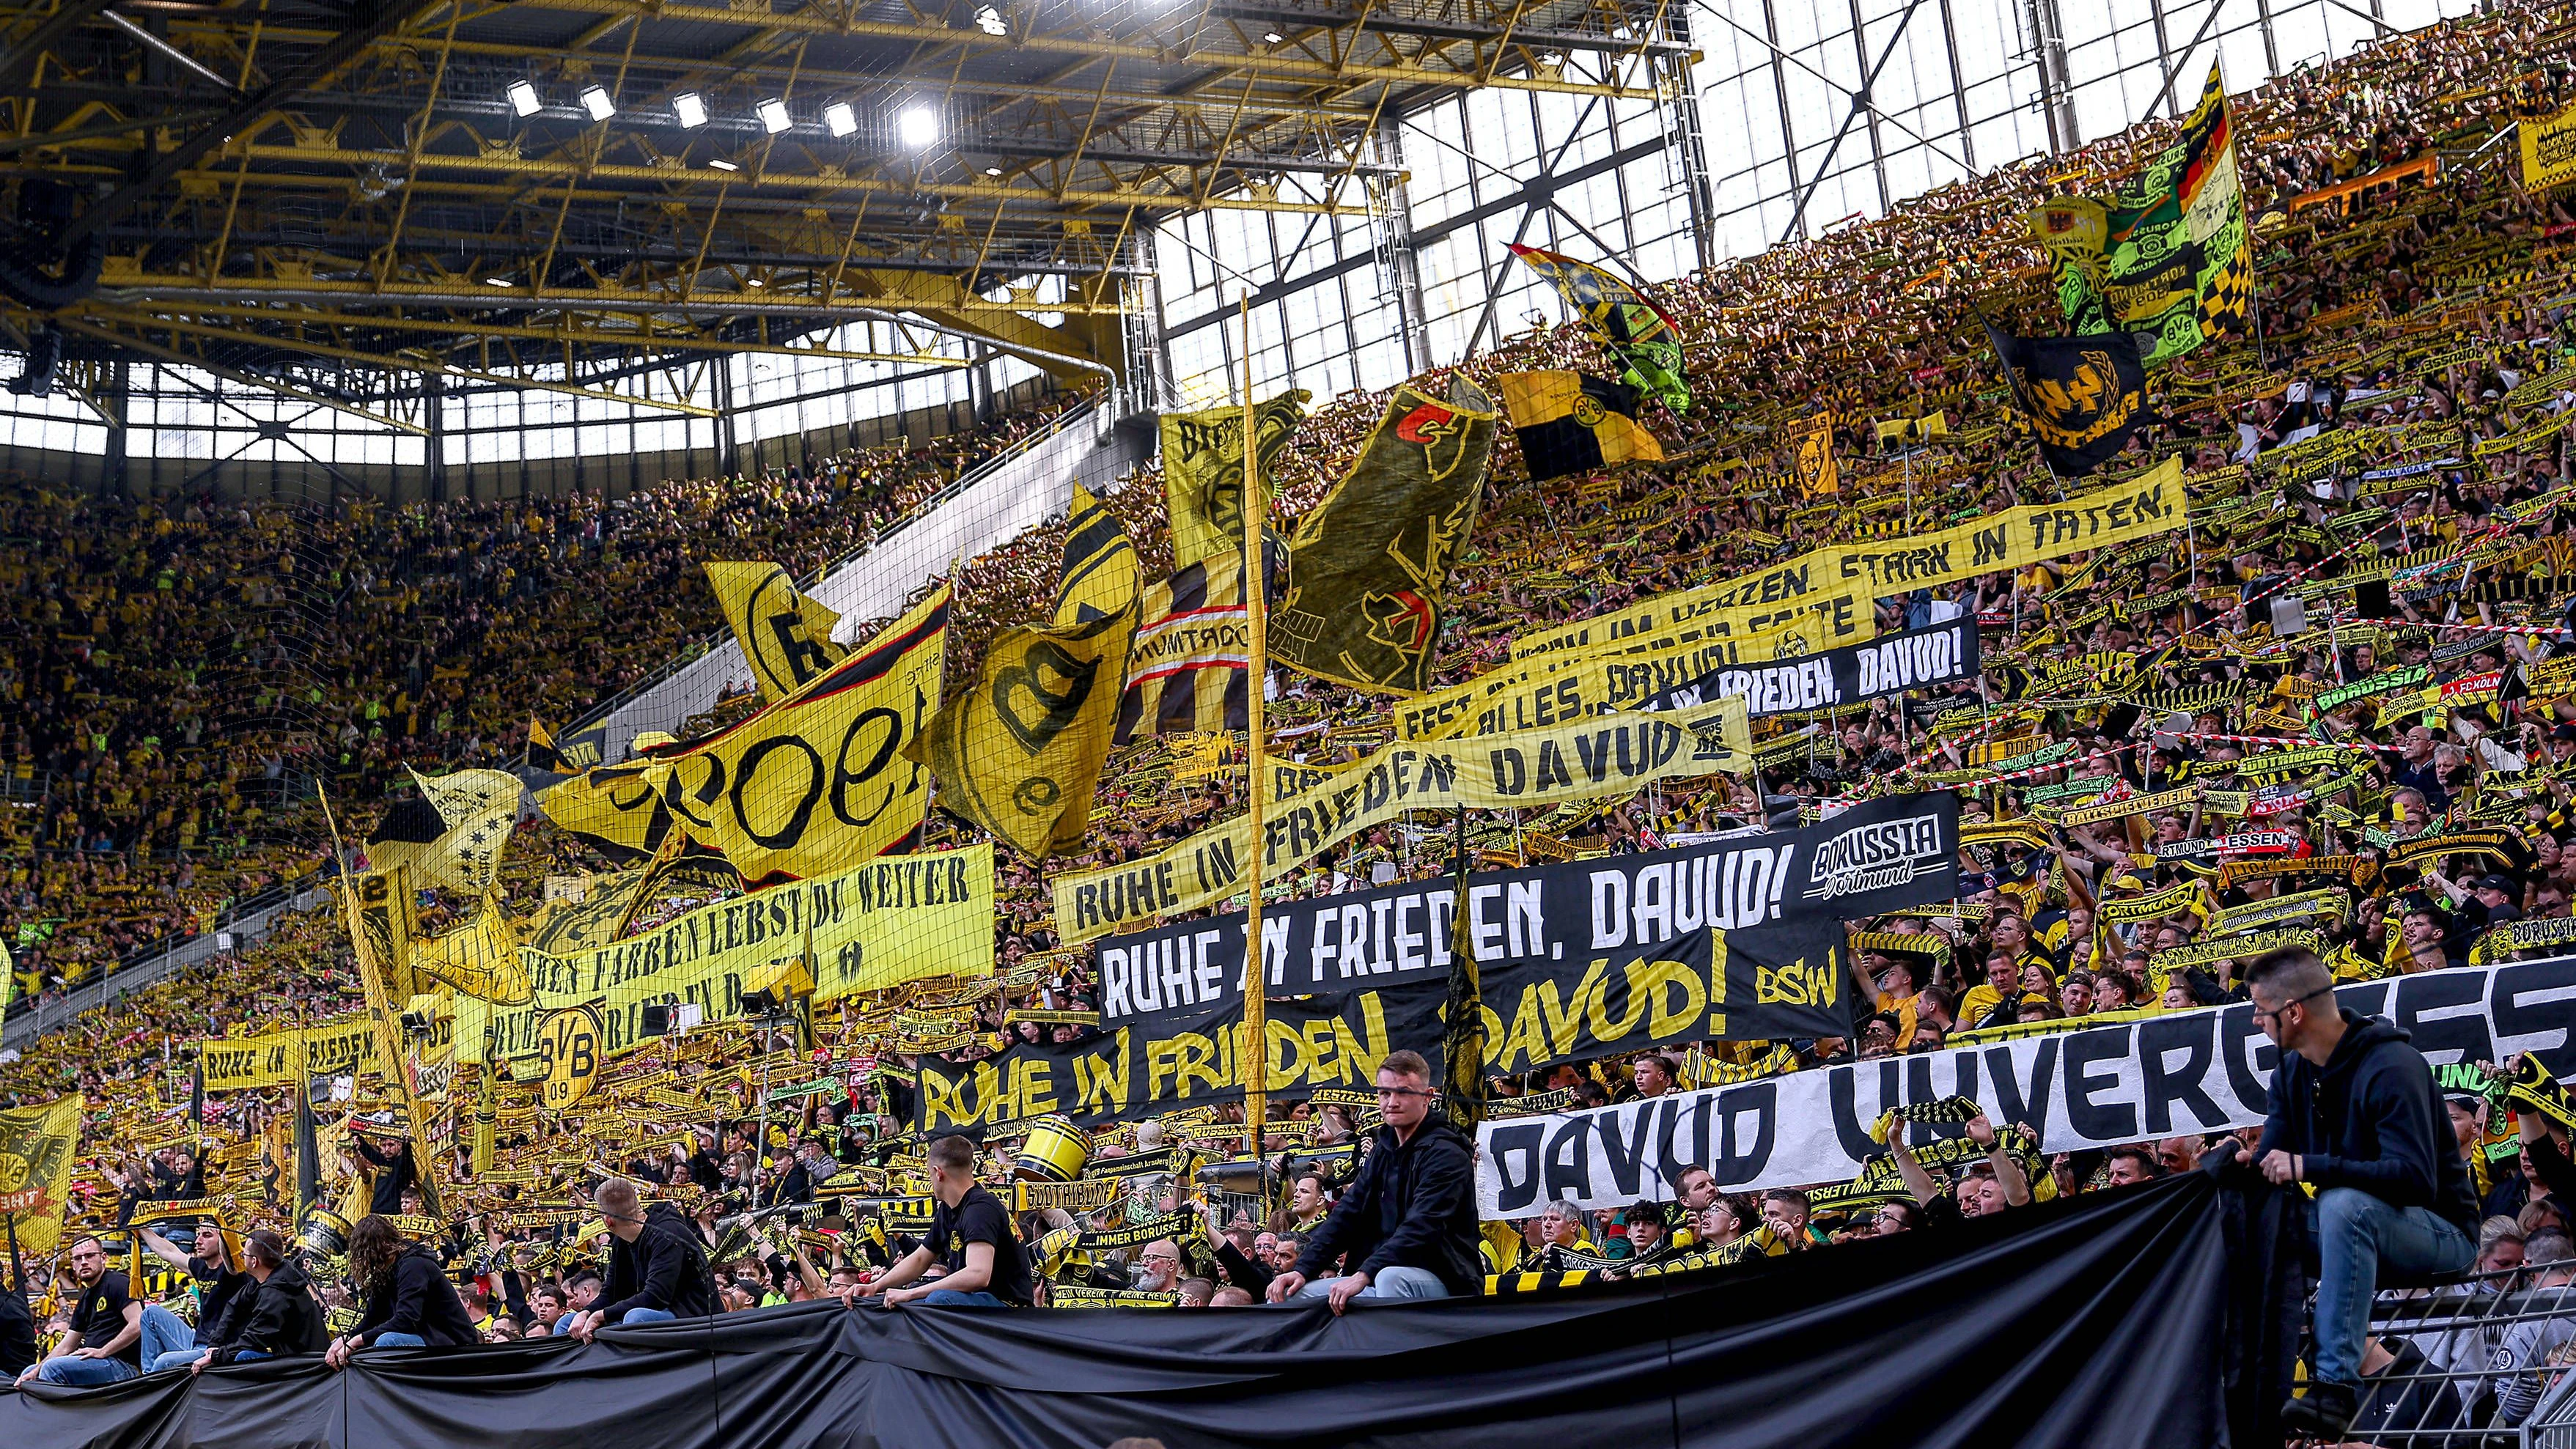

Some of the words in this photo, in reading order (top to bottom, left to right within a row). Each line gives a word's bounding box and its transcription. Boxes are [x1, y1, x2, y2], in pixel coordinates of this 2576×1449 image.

[1578, 397, 1603, 416] BVB
[2484, 432, 2528, 451] BORUSSIA
[1840, 540, 1953, 585] STARK
[1972, 522, 2007, 567] IN
[2028, 483, 2173, 550] TATEN,
[2432, 642, 2469, 659] BORUSSIA
[1718, 656, 1841, 714] FRIEDEN,
[1855, 626, 1962, 696] DAVUD!
[2086, 651, 2136, 682] BVB
[2316, 668, 2428, 710] BORUSSIA
[2473, 676, 2501, 691] KÖLN
[2384, 699, 2426, 721] DORTMUND
[2385, 692, 2423, 712] BORUSSIA
[1404, 693, 1471, 740] FEST
[1075, 860, 1179, 930] RUHE
[1195, 837, 1237, 893] IN
[1265, 750, 1458, 866] FRIEDEN
[1490, 721, 1682, 795] DAVUD
[1812, 814, 1943, 883] BORUSSIA
[2228, 832, 2284, 849] ESSEN
[2400, 835, 2441, 855] Borussia
[2441, 832, 2498, 846] Dortmund
[1824, 859, 1914, 902] Dortmund
[592, 918, 699, 992] FARBEN
[708, 888, 802, 956] LEBST
[812, 877, 846, 930] DU
[857, 855, 969, 908] WEITER
[1104, 929, 1223, 1020] RUHE
[1589, 844, 1795, 951] DAVUD!
[540, 1017, 595, 1082] BVB
[921, 1047, 1059, 1132] RUHE
[1071, 1026, 1131, 1117] IN
[1755, 945, 1837, 1010] BSW
[207, 1041, 253, 1080] RUHE
[266, 1045, 284, 1073] IN
[550, 1080, 570, 1101] 09
[1490, 1083, 1777, 1212] DAVUD
[1939, 1140, 1955, 1154] BVB
[2494, 1140, 2519, 1156] MEISTER
[1169, 1151, 1187, 1168] BVB
[515, 1213, 538, 1226] THE
[1135, 1220, 1181, 1242] BORUSSE
[1055, 1288, 1075, 1300] MEIN
[1119, 1291, 1147, 1300] MEINE
